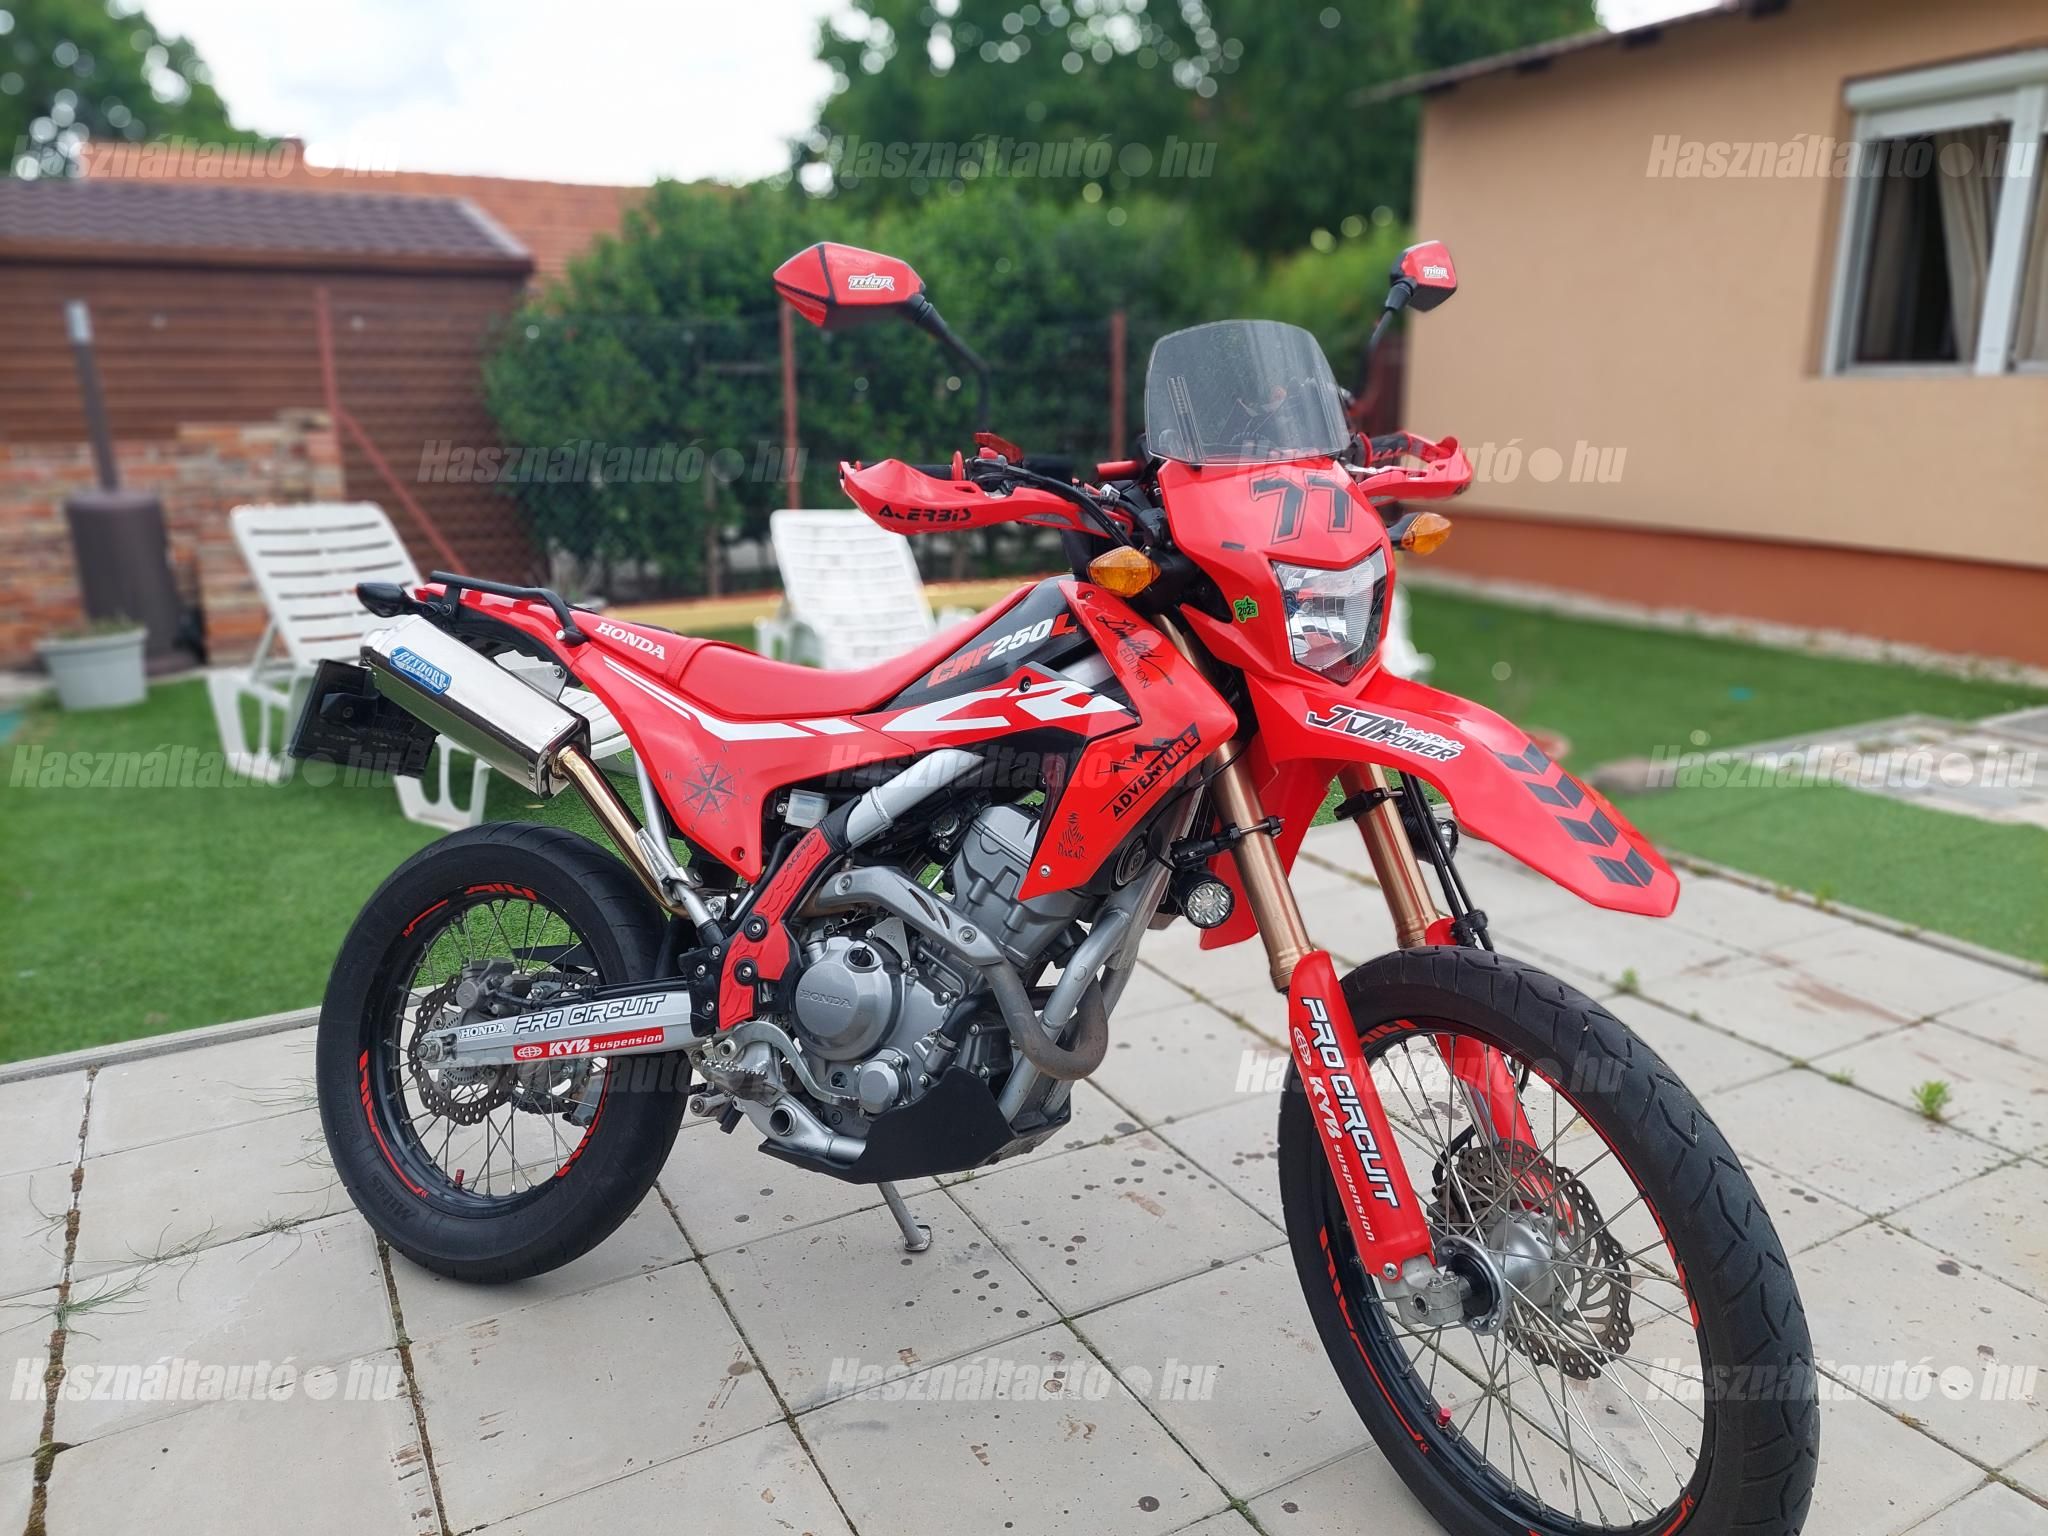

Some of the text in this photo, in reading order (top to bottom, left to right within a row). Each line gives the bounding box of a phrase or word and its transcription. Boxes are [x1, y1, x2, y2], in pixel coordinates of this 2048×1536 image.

[1250, 471, 1352, 544] 77
[594, 621, 665, 660] HONDA
[1120, 647, 1151, 689] EDITION
[1111, 731, 1199, 817] ADVENTURE
[459, 1023, 506, 1039] HONDA
[514, 995, 667, 1035] PRO CIRCUIT
[549, 1033, 663, 1056] KYB suspension
[1302, 998, 1400, 1208] PRO CIRCUIT
[1334, 1144, 1376, 1242] suspension
